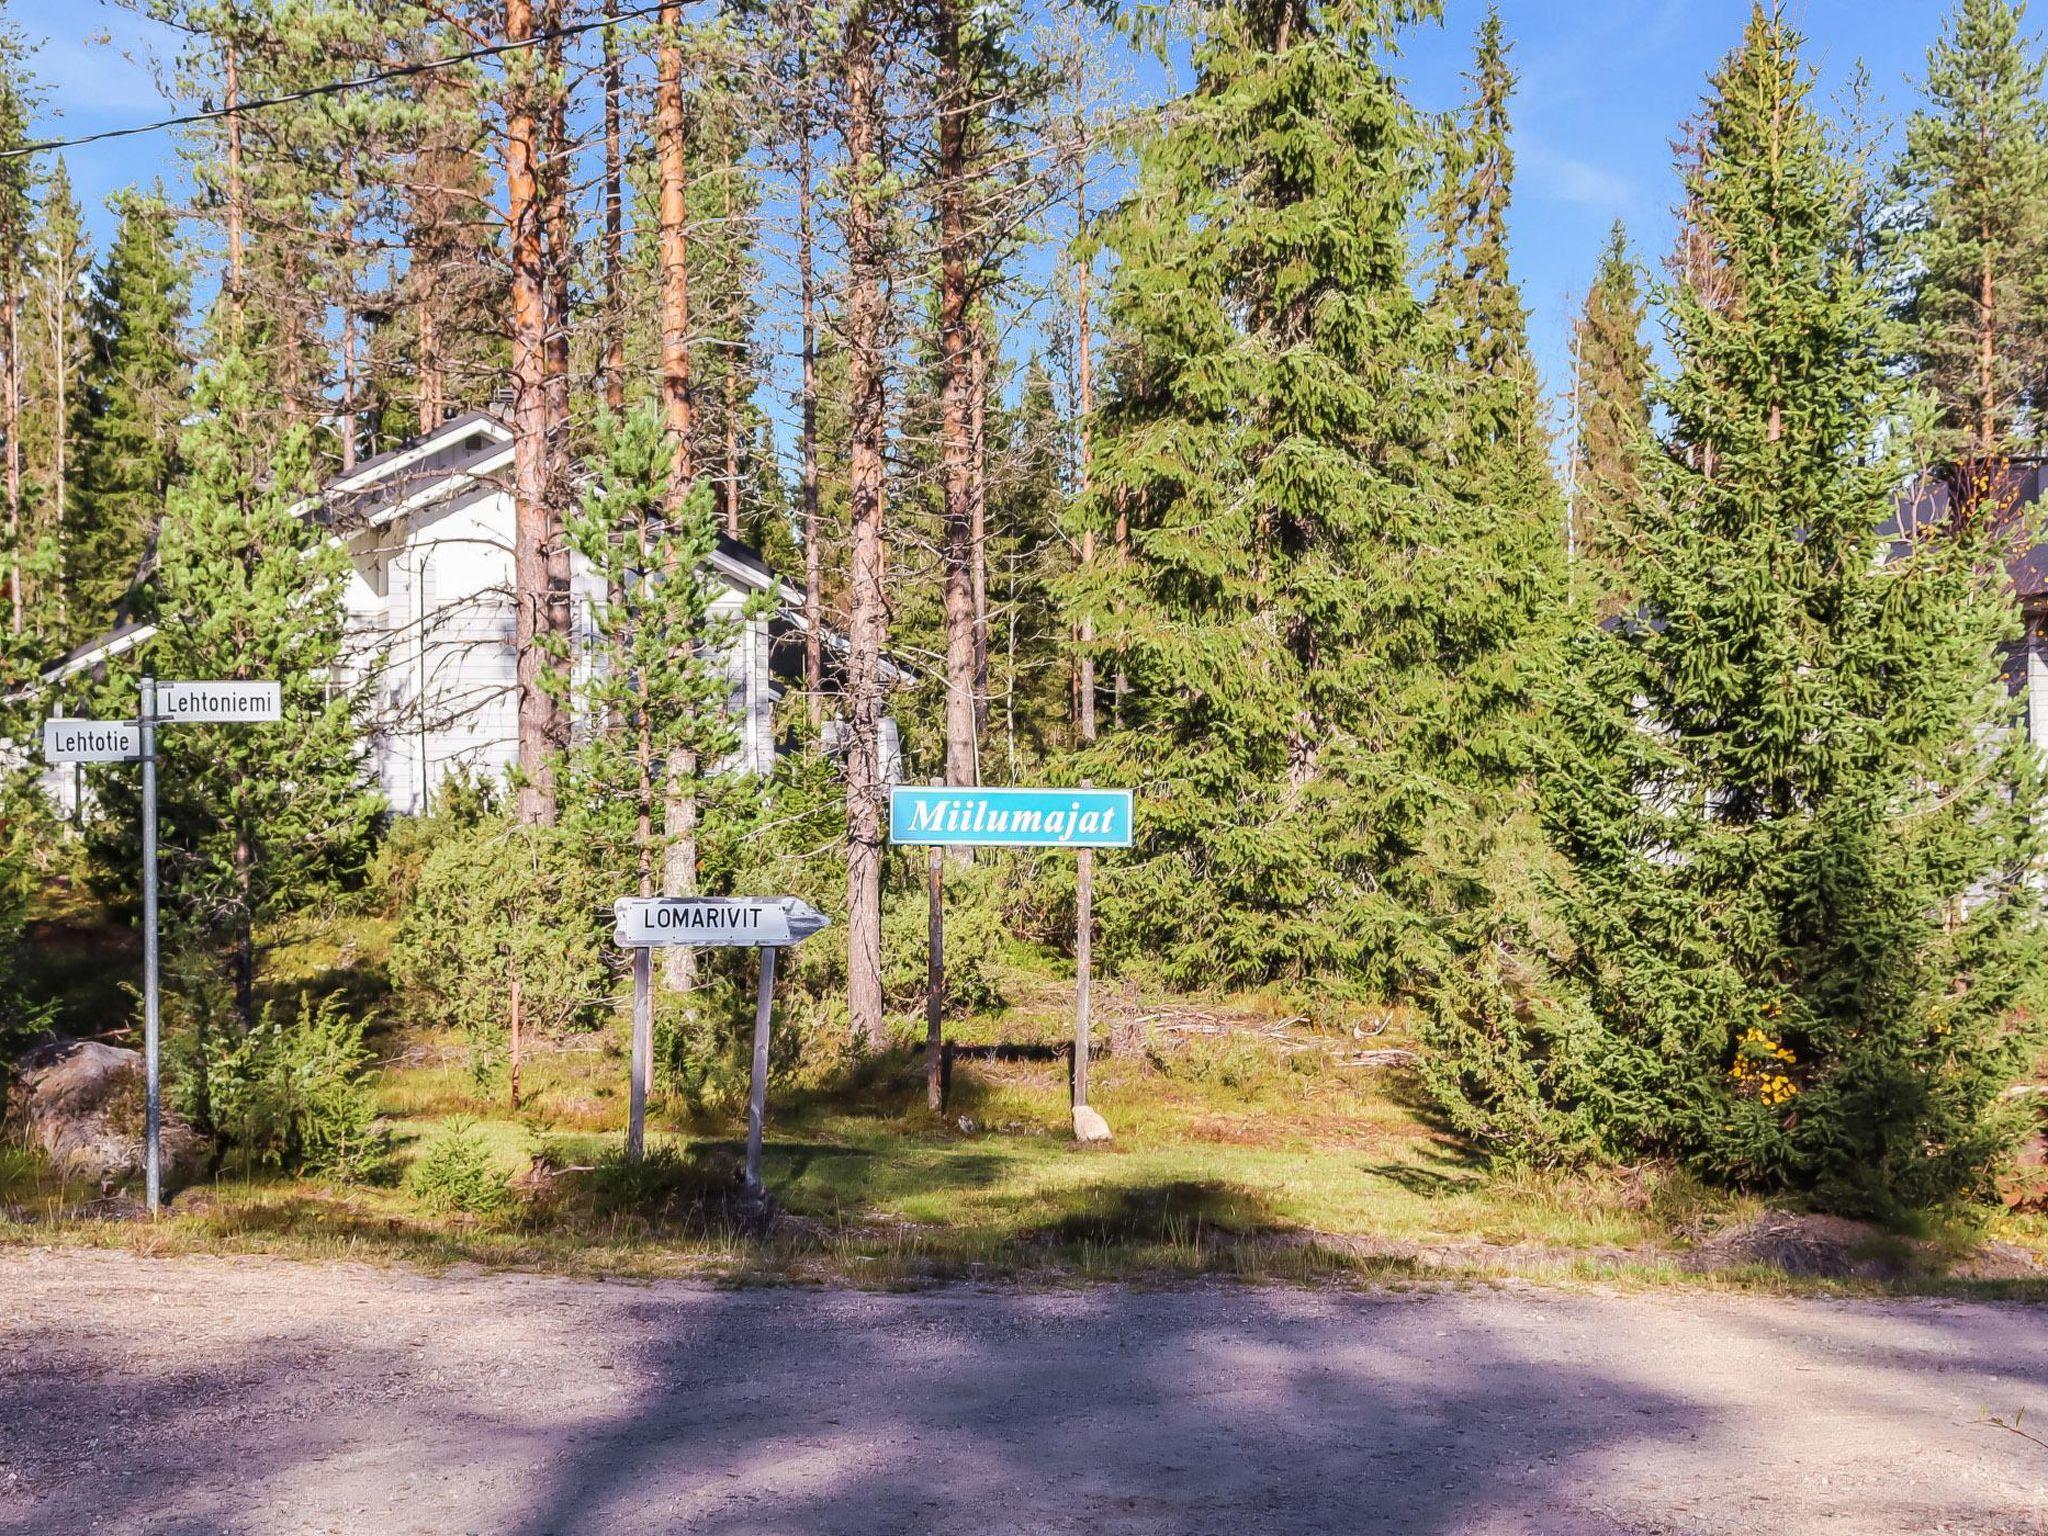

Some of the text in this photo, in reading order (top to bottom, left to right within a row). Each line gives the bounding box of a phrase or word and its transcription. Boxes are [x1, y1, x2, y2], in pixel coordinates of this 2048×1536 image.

[167, 691, 272, 713] Lehtoniemi
[54, 730, 130, 753] Lehtotie
[908, 799, 1115, 841] Miilumajat
[644, 907, 763, 929] LOMARIVIT
